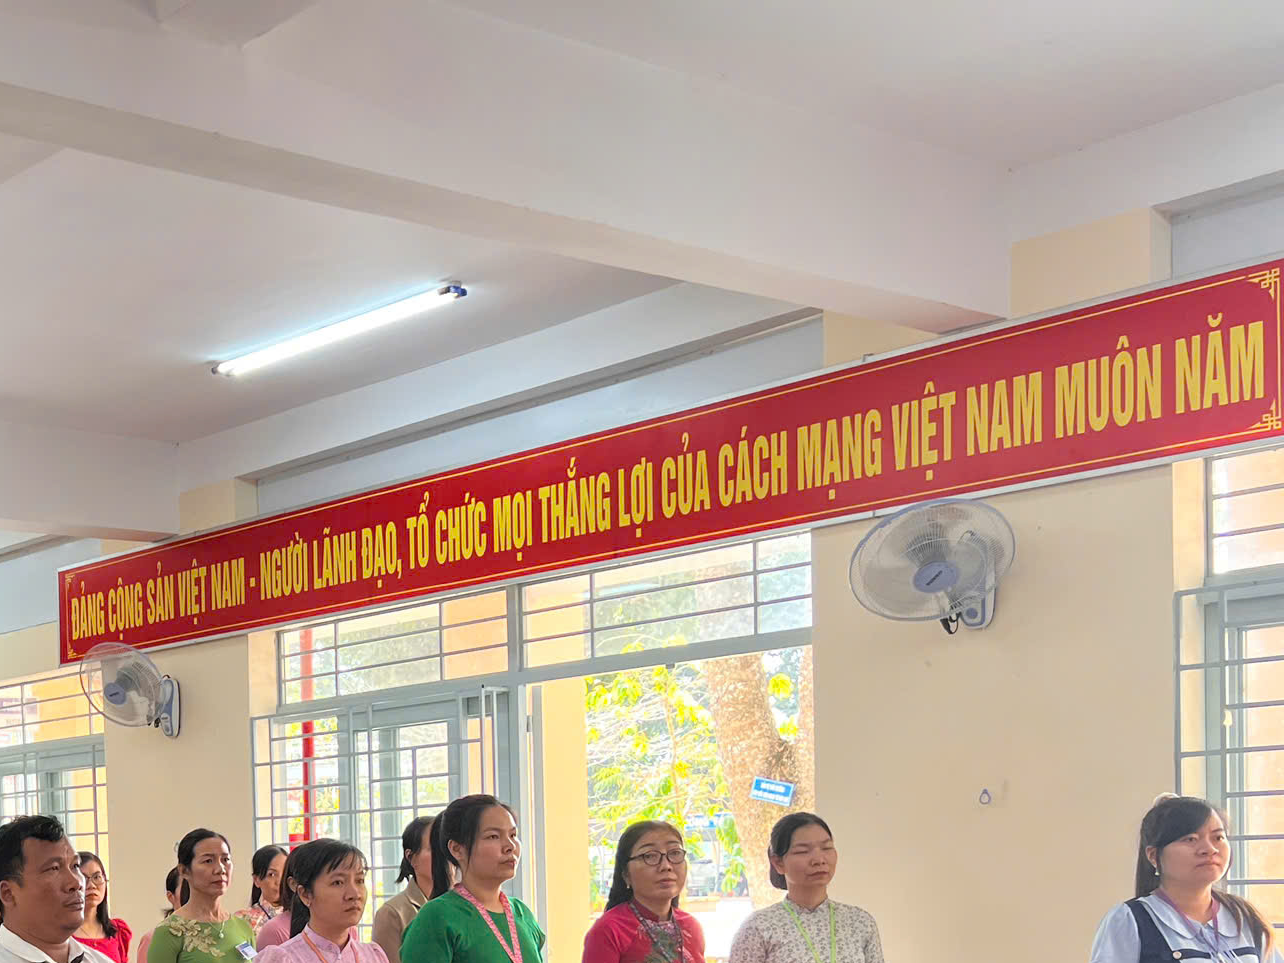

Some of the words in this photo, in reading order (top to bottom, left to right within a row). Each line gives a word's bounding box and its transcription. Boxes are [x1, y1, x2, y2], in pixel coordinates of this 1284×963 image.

[71, 580, 105, 641] ĐẢNG
[107, 577, 143, 641] CỘNG
[146, 561, 175, 625] SẢN
[177, 558, 207, 625] VIỆT
[210, 557, 245, 611] NAM
[259, 532, 310, 601] NGƯỜI
[313, 527, 357, 590] LÃNH
[361, 521, 402, 589] ĐẠO,
[406, 491, 430, 570] TỔ
[435, 492, 487, 565] CHỨC
[492, 490, 533, 562] MỌI
[538, 456, 611, 543] THẮNG
[617, 456, 654, 538] LỢI
[661, 431, 711, 519] CỦA
[718, 425, 788, 507] CÁCH
[797, 408, 882, 500] MẠNG
[891, 381, 957, 481] VIỆT
[966, 370, 1043, 457] NAM
[1054, 335, 1162, 439] MUÔN
[1174, 311, 1265, 415] NĂM
